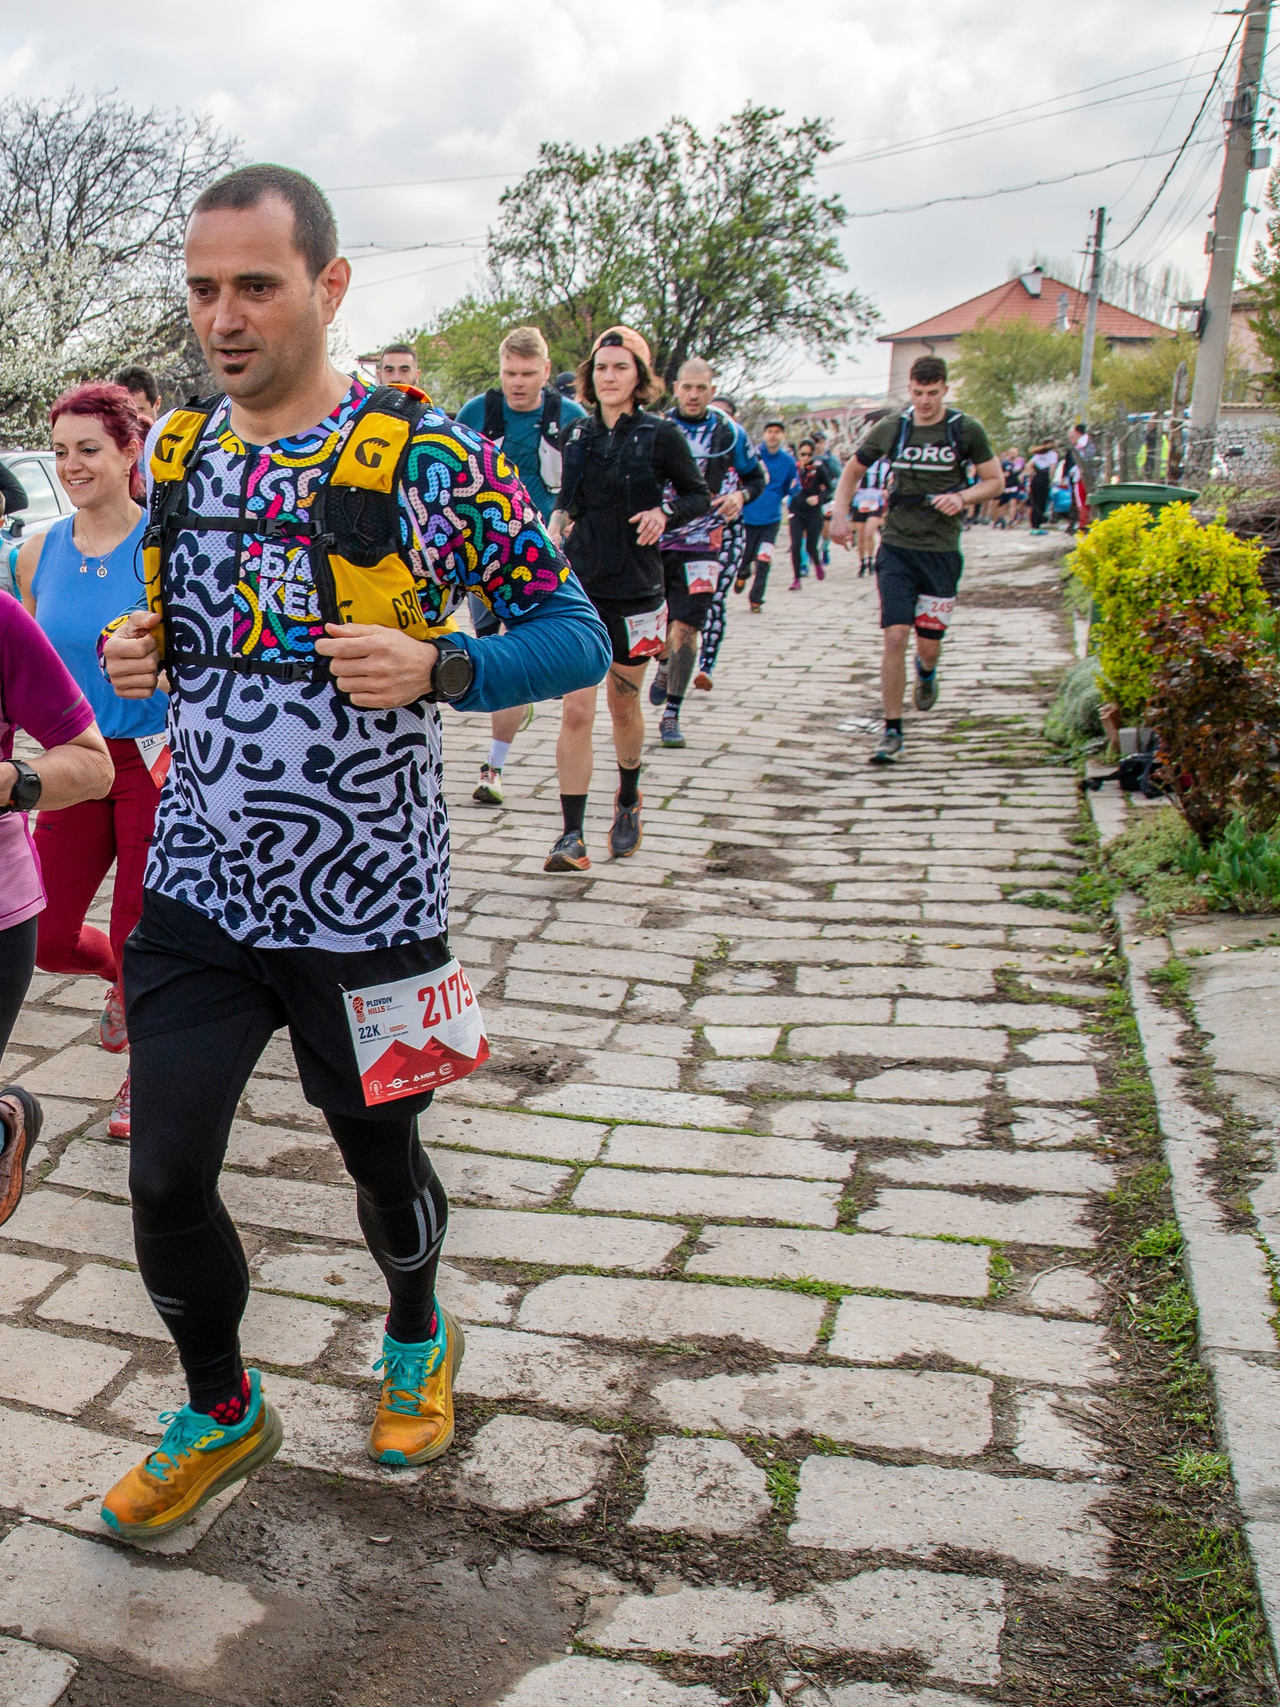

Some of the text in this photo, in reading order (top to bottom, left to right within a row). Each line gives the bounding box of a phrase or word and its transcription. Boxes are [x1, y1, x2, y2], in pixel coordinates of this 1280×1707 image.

[896, 445, 956, 463] ORG
[141, 736, 156, 749] 22K
[366, 996, 393, 1008] PLOVDIV
[367, 1005, 386, 1015] HILLS
[358, 1023, 381, 1040] 22K
